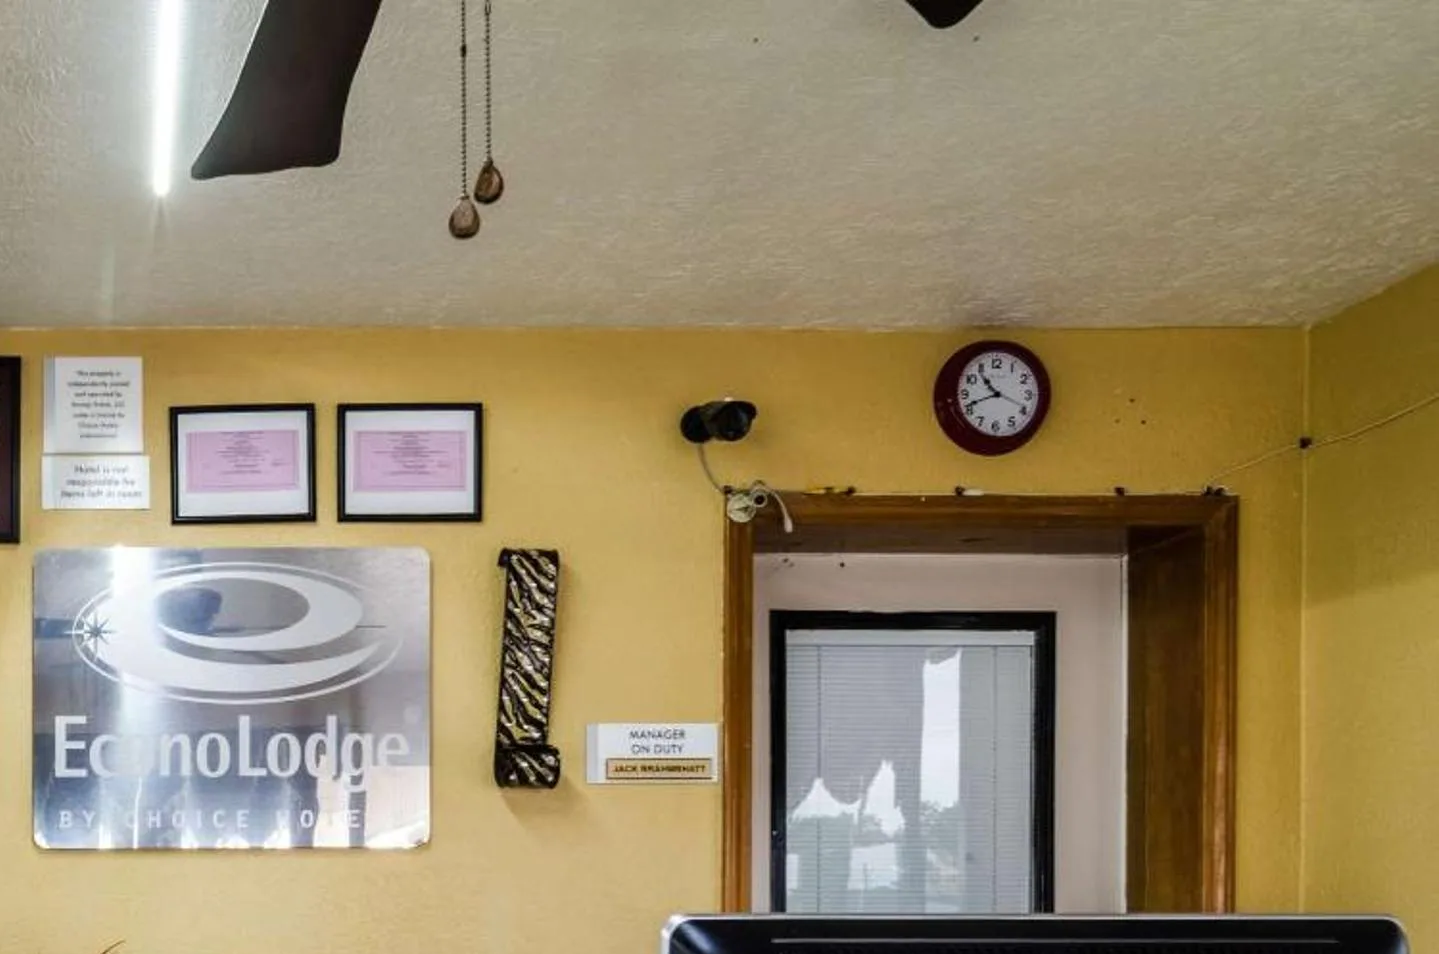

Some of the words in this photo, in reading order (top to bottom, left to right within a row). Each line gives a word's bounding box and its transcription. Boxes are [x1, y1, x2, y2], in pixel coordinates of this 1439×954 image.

[991, 358, 1002, 369] 12
[966, 373, 978, 385] 10
[1019, 373, 1028, 385] 2
[960, 389, 969, 400] 9
[1024, 389, 1033, 401] 3
[1019, 405, 1027, 416] 4
[975, 415, 985, 427] 7
[991, 420, 1001, 432] 6
[1007, 415, 1016, 427] 5
[629, 728, 686, 741] MANAGER
[54, 714, 410, 793] EcnoLodge
[631, 743, 651, 755] ON
[653, 743, 684, 755] DUTY
[58, 809, 97, 829] BY
